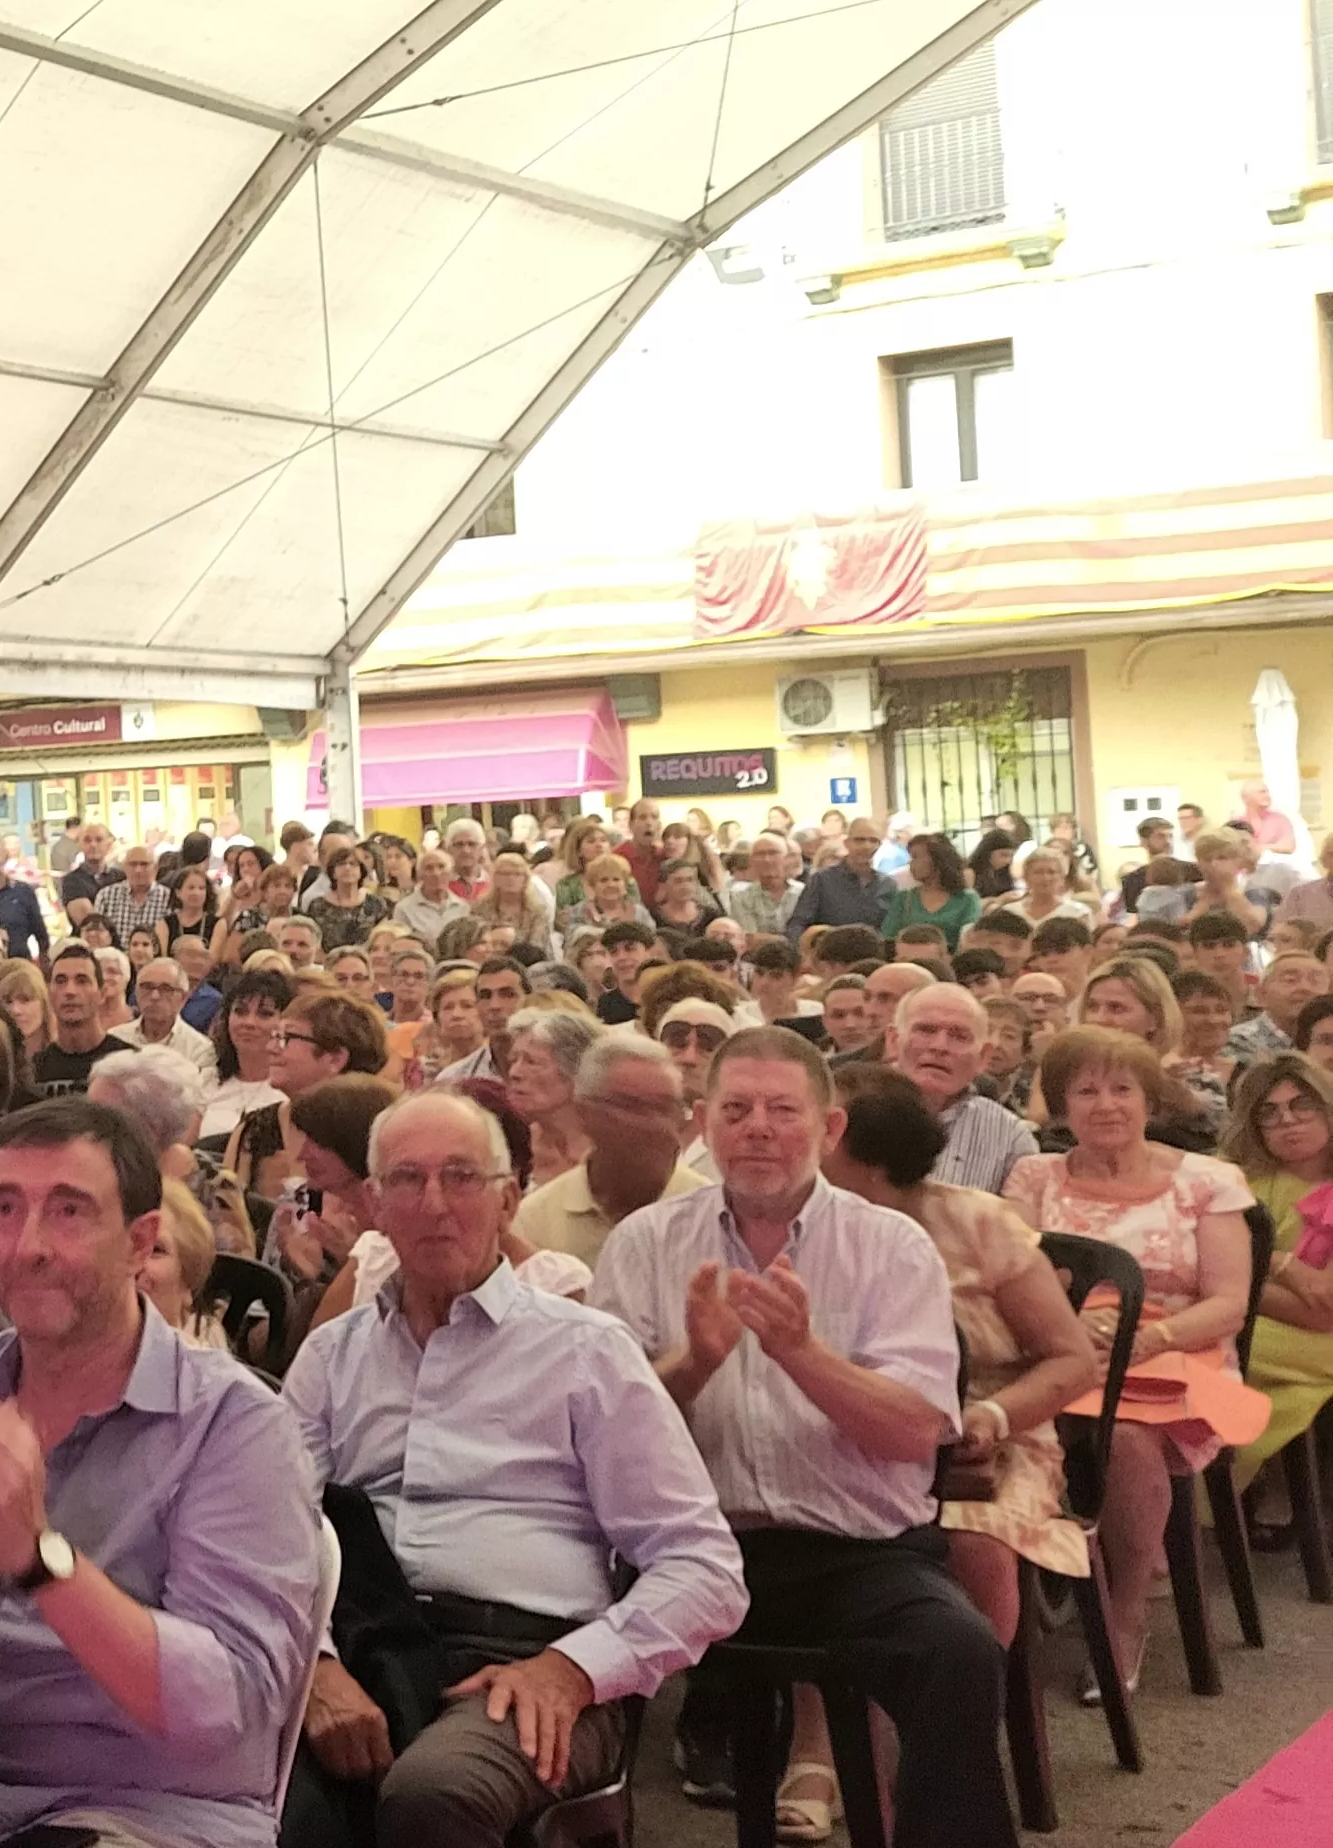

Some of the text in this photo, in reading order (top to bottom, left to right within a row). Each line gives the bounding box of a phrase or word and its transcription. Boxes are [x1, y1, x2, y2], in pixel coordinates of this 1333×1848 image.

[9, 717, 106, 738] Centro Cultural
[650, 754, 763, 780] REQUITOS
[734, 766, 769, 789] 2.0
